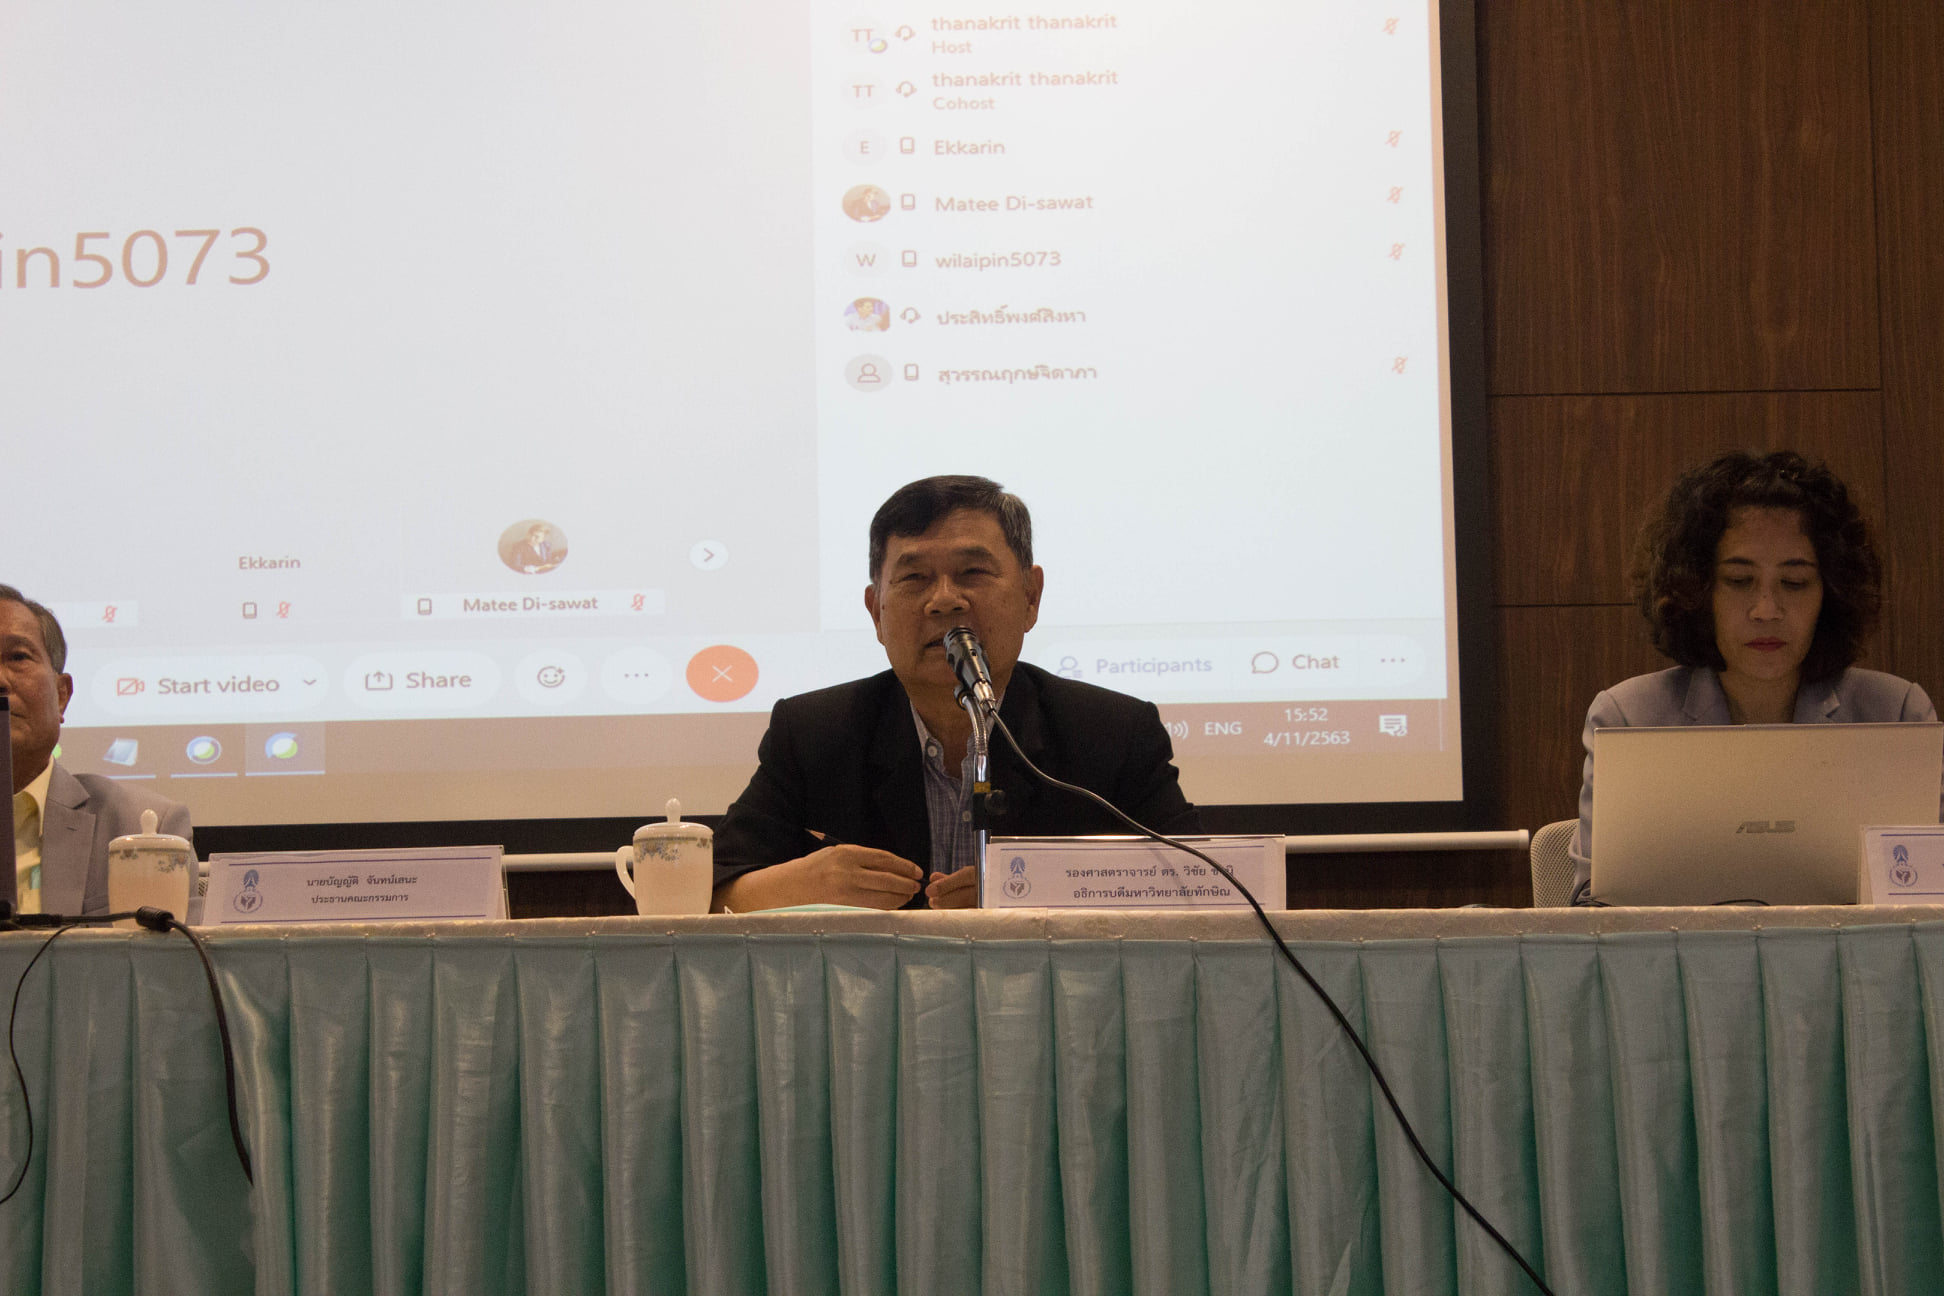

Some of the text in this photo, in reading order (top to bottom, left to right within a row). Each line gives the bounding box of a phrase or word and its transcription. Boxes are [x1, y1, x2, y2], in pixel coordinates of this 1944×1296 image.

[931, 14, 1117, 31] thanakrit thanakrit
[932, 40, 972, 54] Host
[932, 70, 1118, 87] thanakrit thanakrit
[853, 85, 874, 98] TT
[933, 96, 995, 110] Cohost
[860, 141, 869, 154] E
[934, 140, 1005, 155] Ekkarin
[936, 196, 1093, 211] Matee Di-sawat
[0, 227, 269, 288] n5073
[936, 251, 1061, 271] wilaipin5073
[239, 556, 300, 569] Ekkarin
[464, 597, 598, 612] Matee Di-sawat
[1097, 658, 1212, 676] Participants
[1292, 654, 1339, 669] Chat
[158, 675, 280, 694] Start video
[407, 672, 472, 688] Share
[1285, 708, 1328, 721] 15:52
[1205, 721, 1242, 735] ENG
[1264, 731, 1350, 746] 4/11/2563
[1736, 820, 1796, 834] ASUS
[1066, 865, 1156, 877] รองศาสตราจารย์
[1161, 866, 1179, 877] ดร.
[1183, 864, 1207, 877] วิชัย
